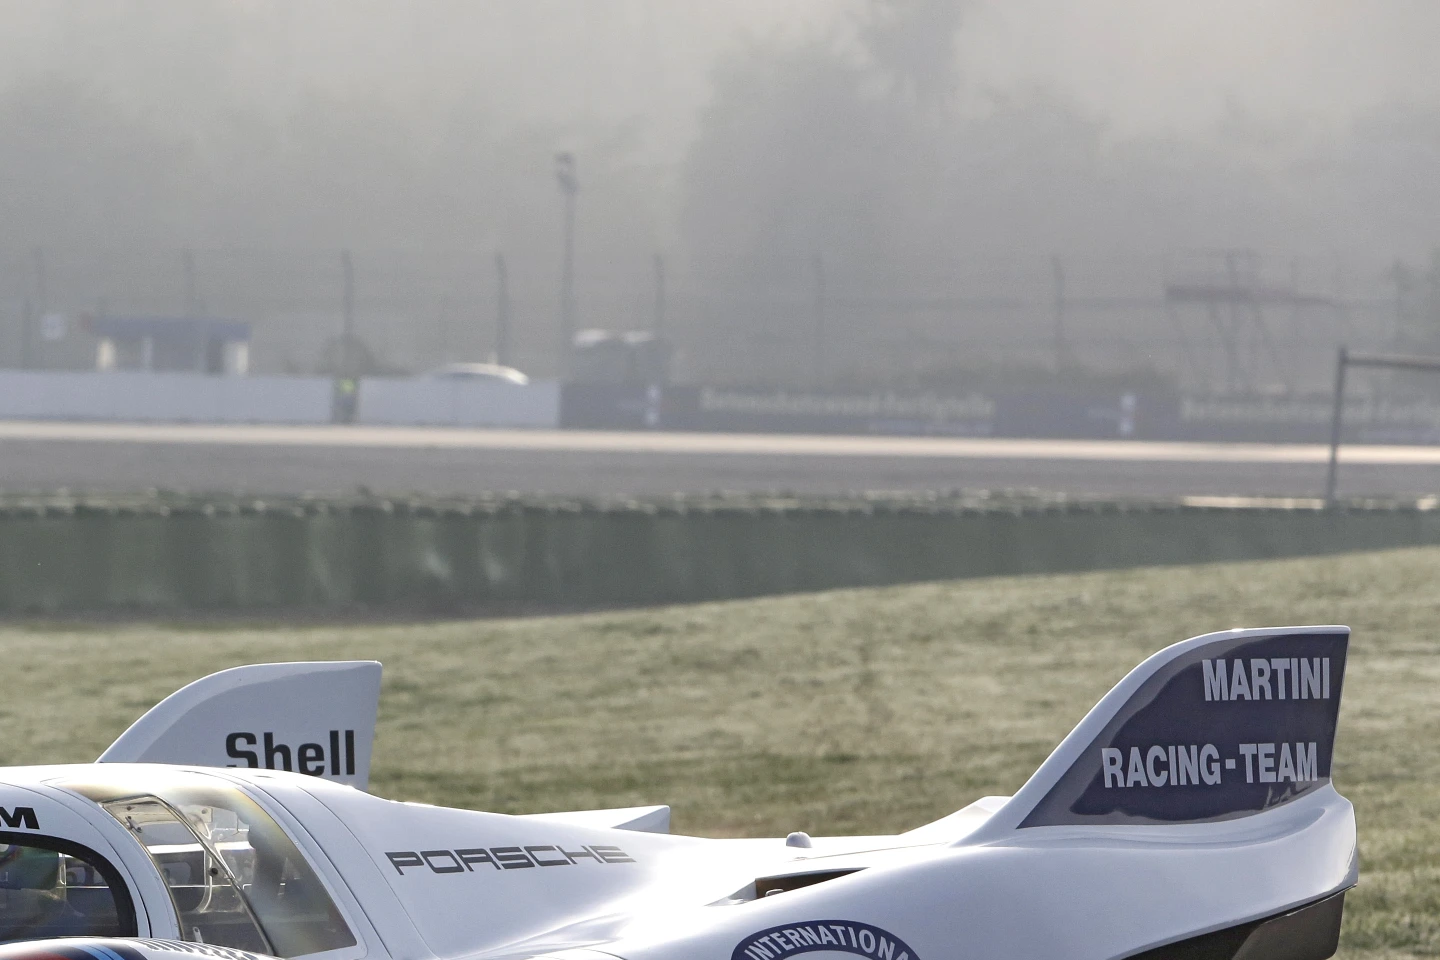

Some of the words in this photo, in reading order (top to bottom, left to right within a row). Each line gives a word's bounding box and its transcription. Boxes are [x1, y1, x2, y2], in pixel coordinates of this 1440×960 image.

[1201, 657, 1331, 702] MARTINI
[225, 730, 356, 776] Shell
[384, 845, 637, 876] PORSCHE
